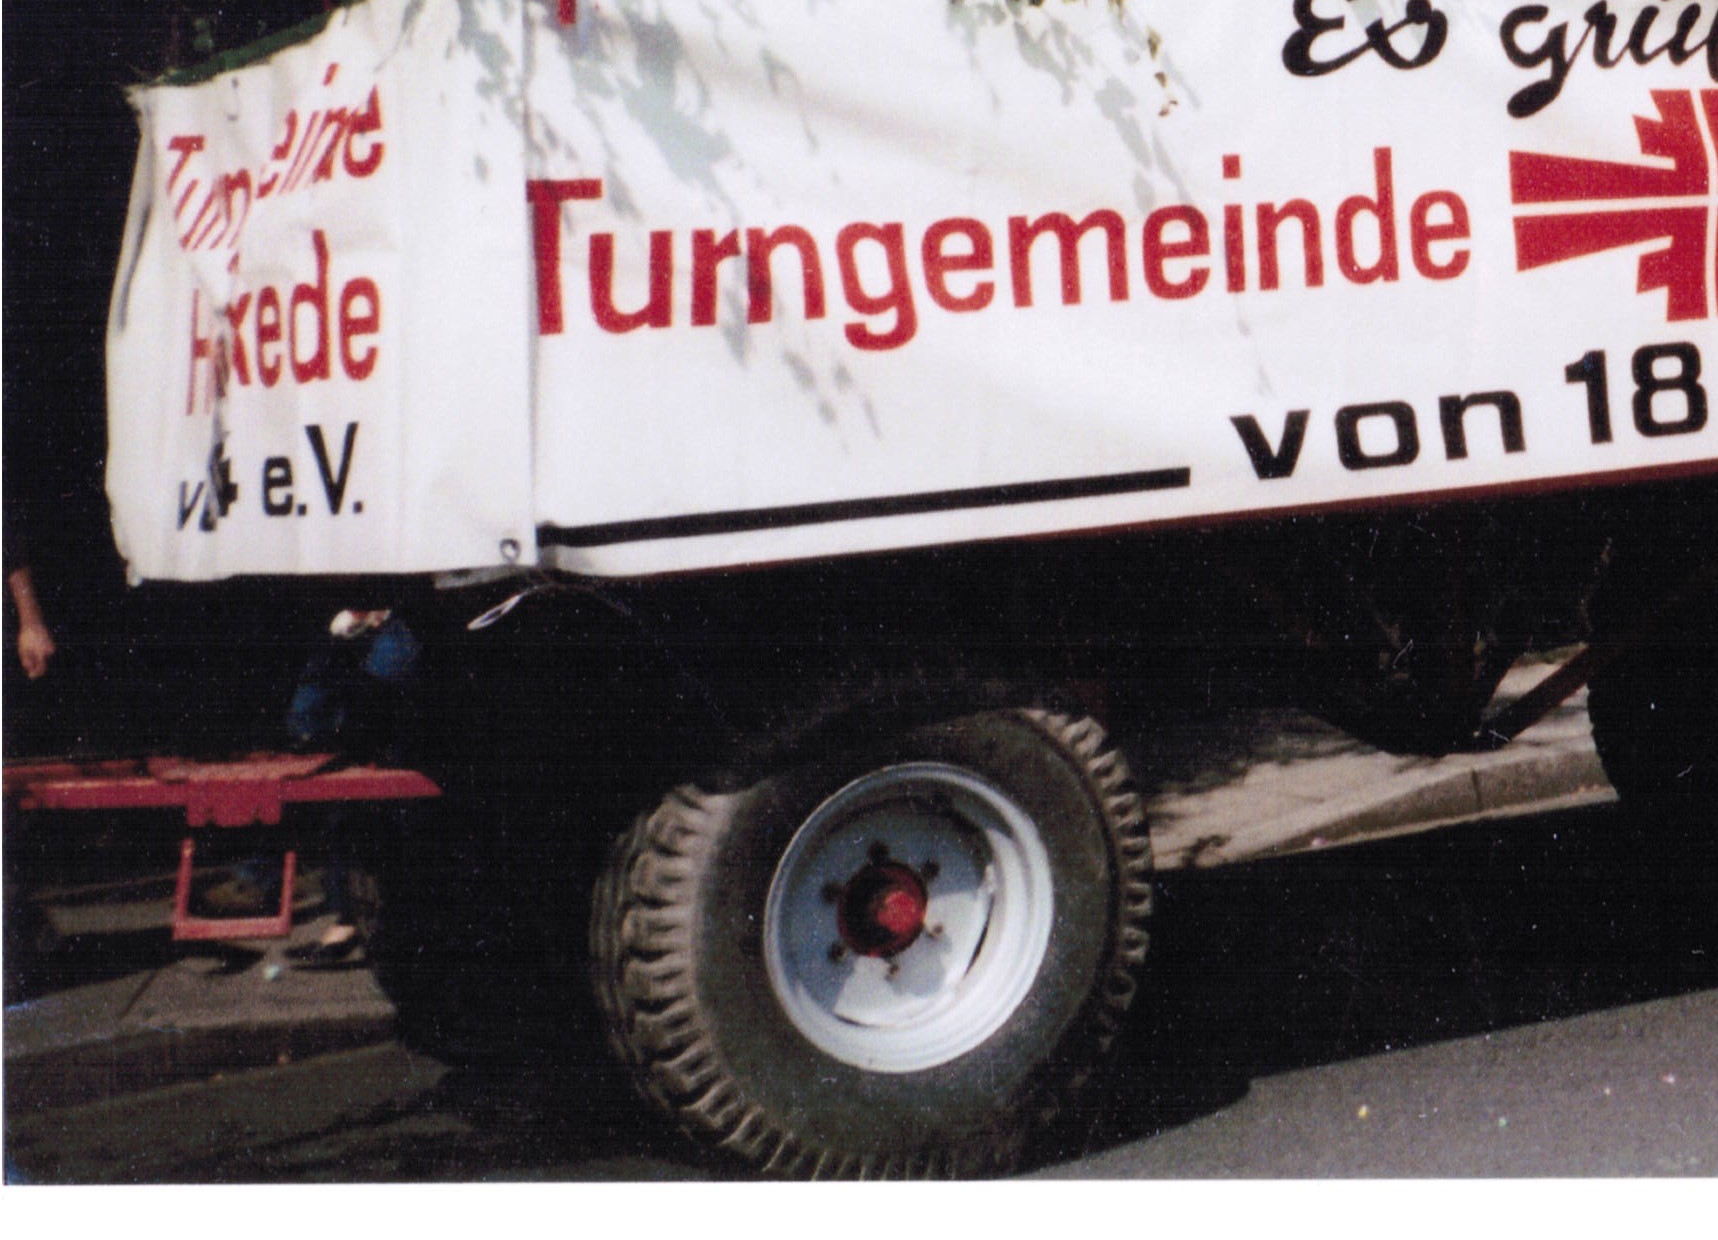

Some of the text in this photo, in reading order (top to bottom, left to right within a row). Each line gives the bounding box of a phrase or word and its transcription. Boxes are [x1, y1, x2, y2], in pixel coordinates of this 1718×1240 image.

[526, 145, 1472, 353] Turngemeinde
[261, 422, 364, 517] e.V.
[1230, 389, 1527, 481] von
